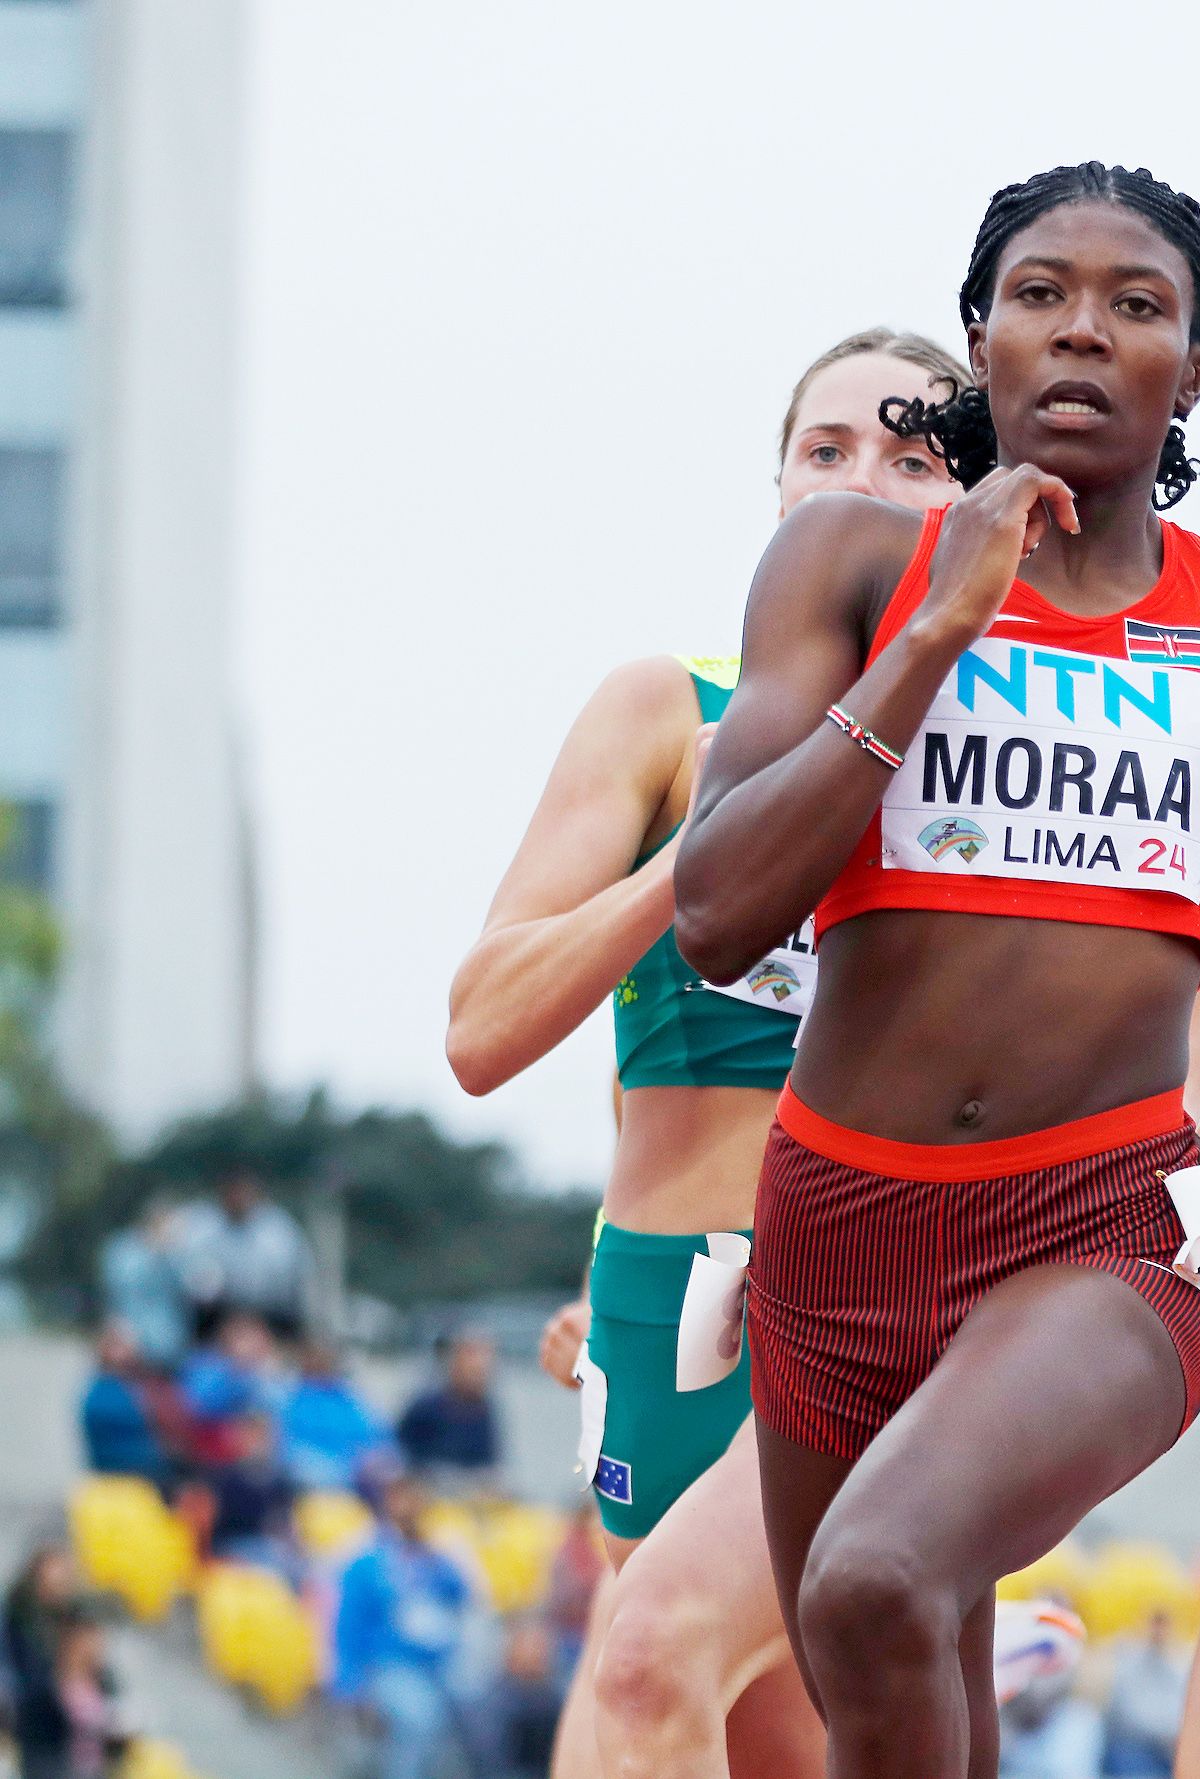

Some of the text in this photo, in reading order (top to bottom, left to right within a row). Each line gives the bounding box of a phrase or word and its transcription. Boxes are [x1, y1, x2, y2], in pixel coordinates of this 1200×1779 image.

[956, 646, 1172, 736] NTN
[922, 732, 1191, 833] MORAA
[1003, 826, 1187, 880] LIMA 24
